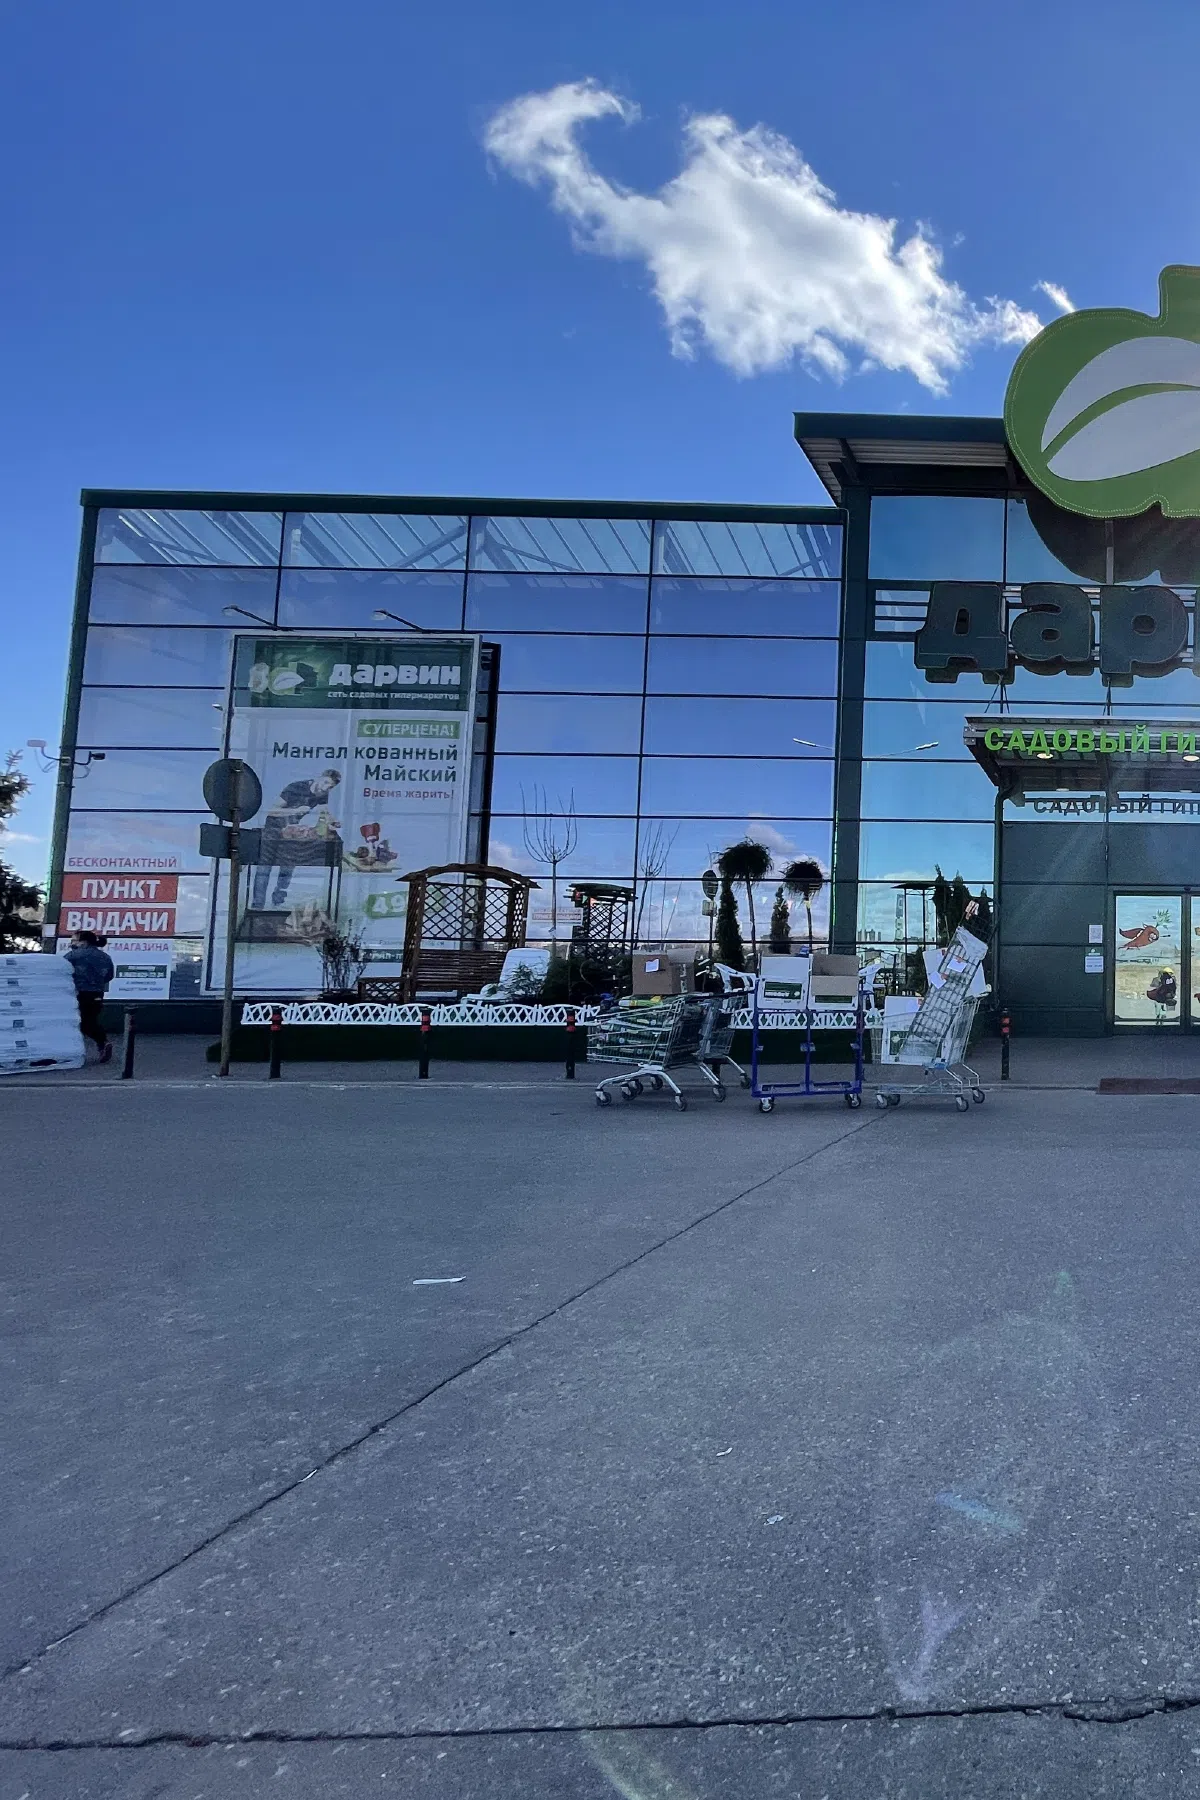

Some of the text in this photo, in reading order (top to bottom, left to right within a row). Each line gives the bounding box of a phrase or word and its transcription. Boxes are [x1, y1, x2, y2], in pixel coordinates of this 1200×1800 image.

[328, 664, 461, 687] дарвин
[362, 723, 455, 738] СУПЕРЦЕНА!
[984, 724, 1150, 756] САДОВЫЙ
[272, 742, 458, 761] Мангал кованный
[364, 764, 457, 782] Майский
[363, 788, 455, 800] Время жарить!
[68, 856, 177, 868] БЕСКОНТАКТНЫЙ
[81, 879, 161, 899] ПУНКТ
[66, 911, 169, 935] ВЫДАЧИ
